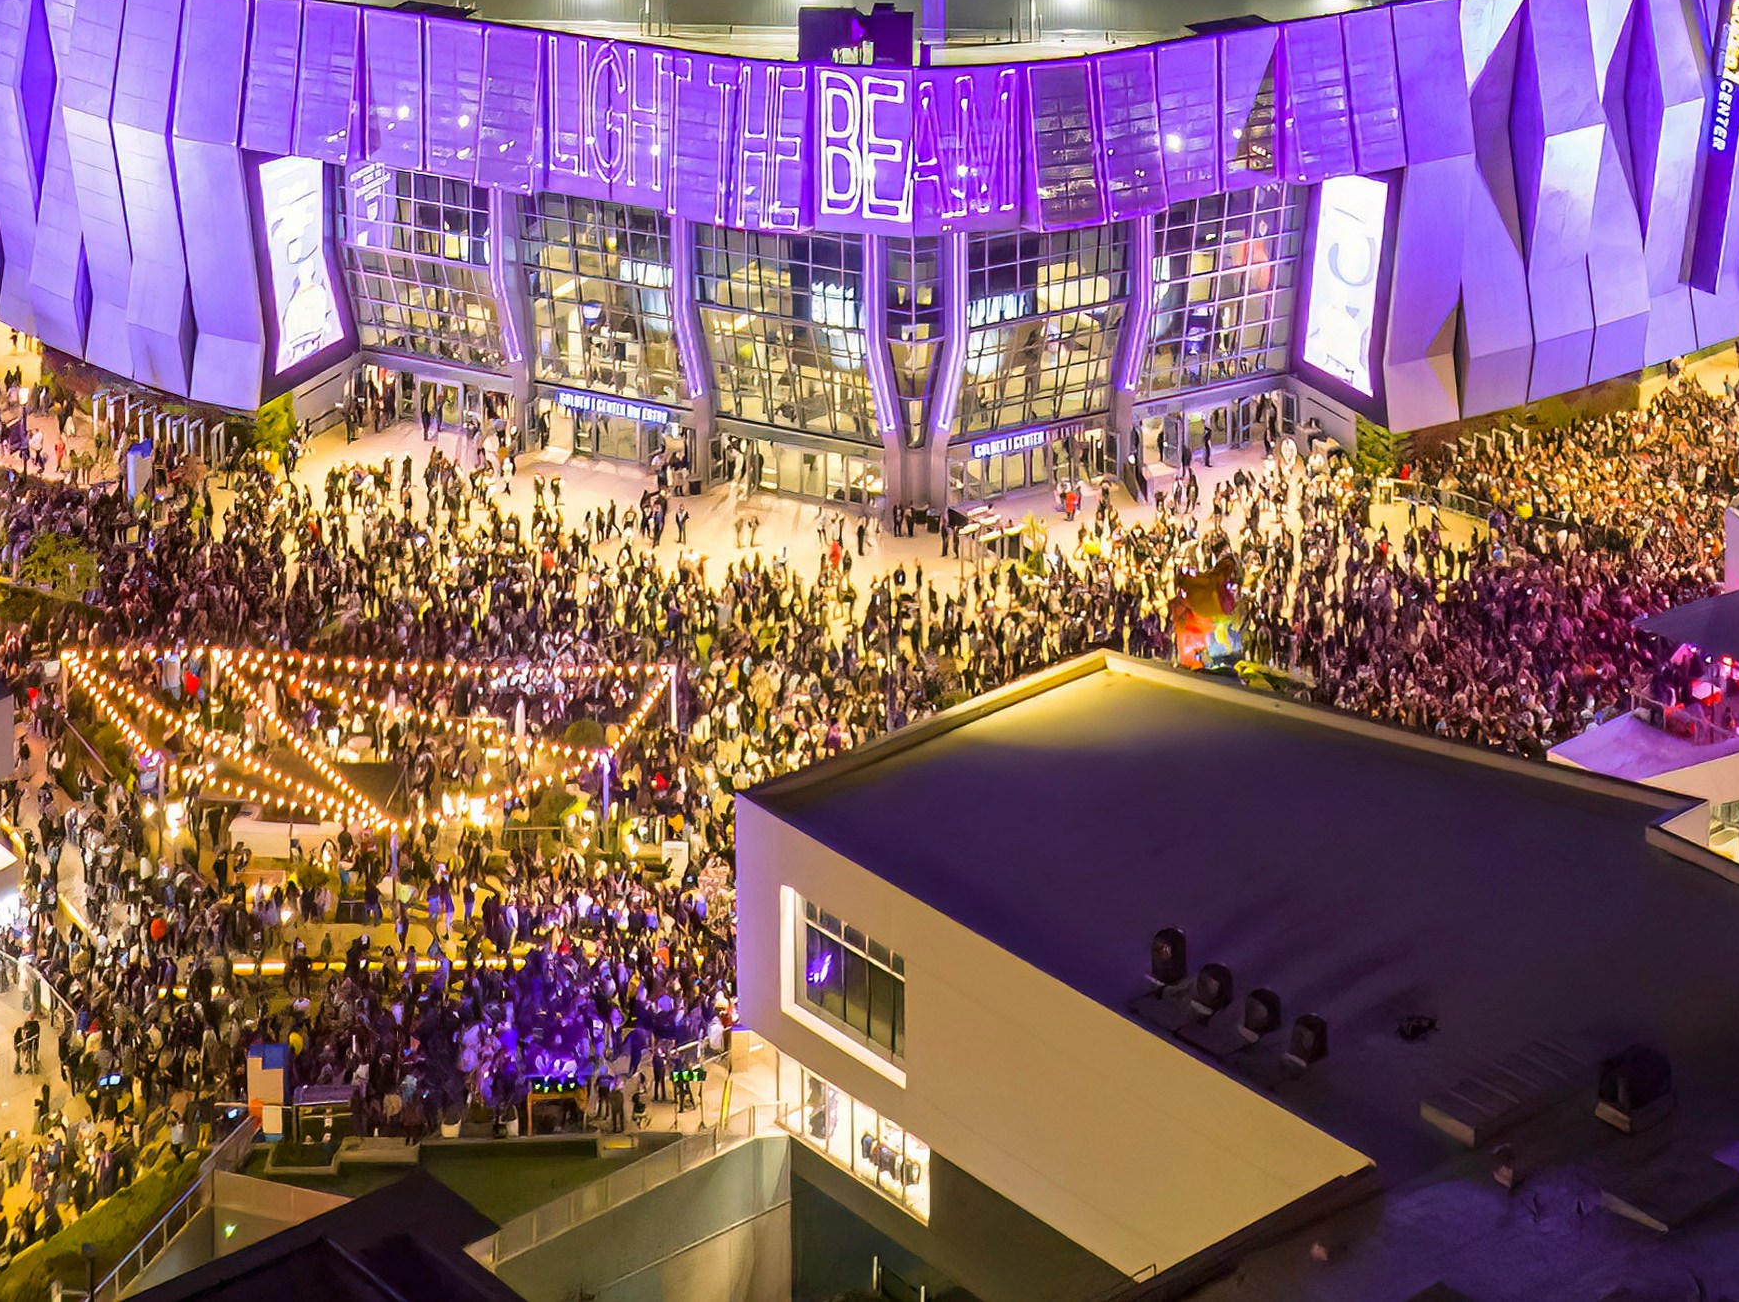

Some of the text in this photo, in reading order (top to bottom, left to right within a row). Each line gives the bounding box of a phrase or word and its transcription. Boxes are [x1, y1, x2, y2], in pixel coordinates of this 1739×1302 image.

[548, 35, 1016, 230] LIGHT THE BEAM
[1712, 79, 1734, 151] CENTER
[596, 398, 626, 417] CENTER
[1013, 431, 1045, 449] CENTER
